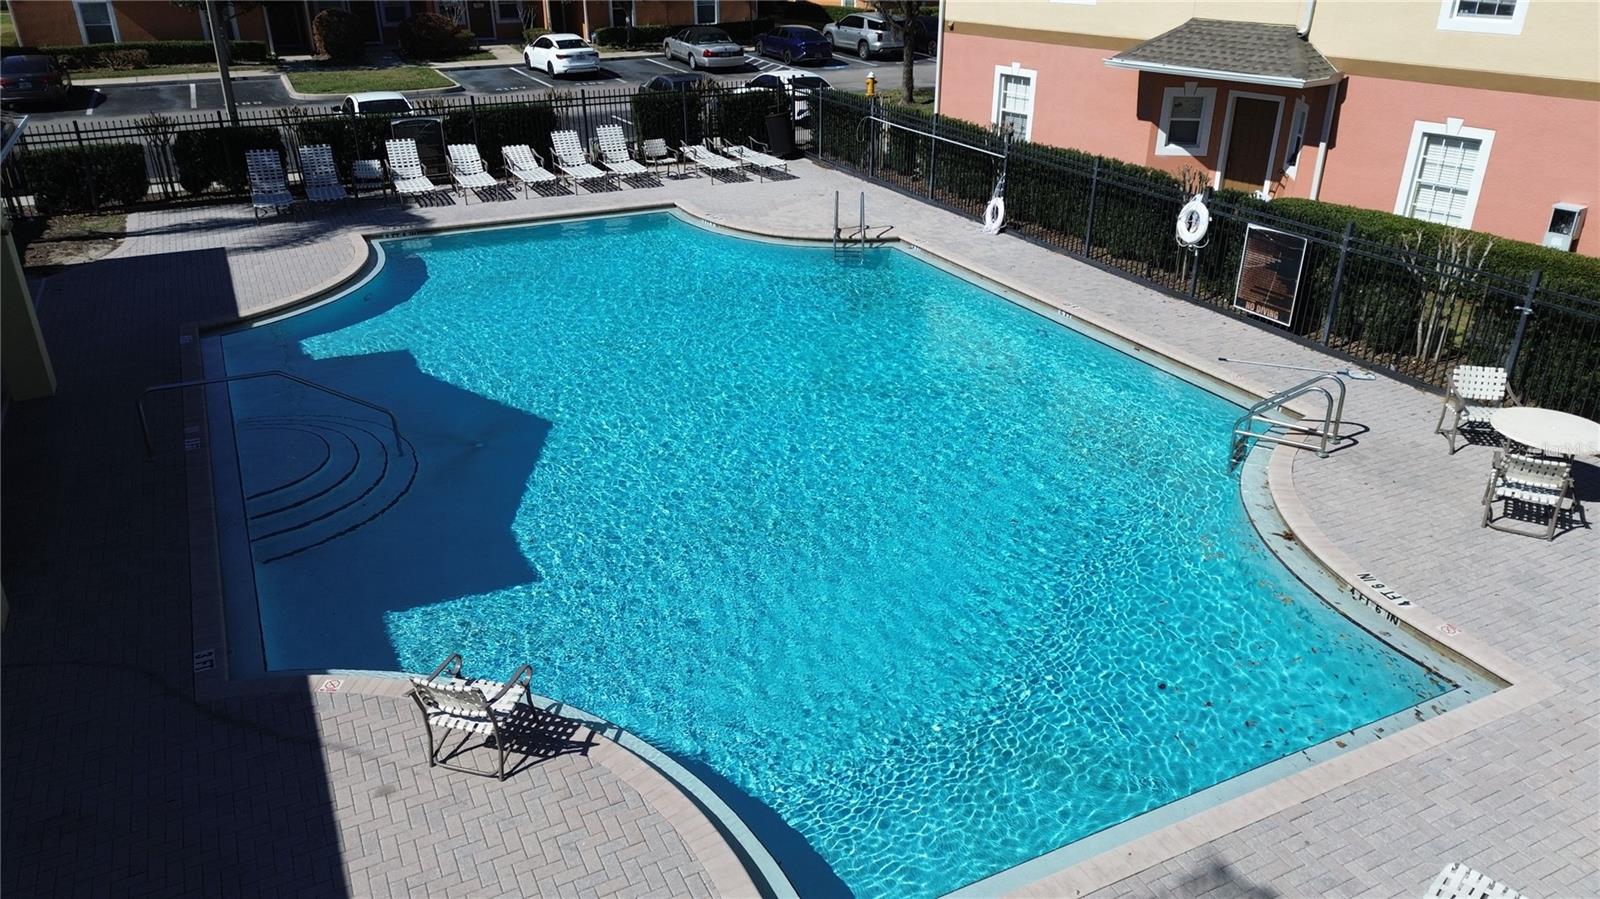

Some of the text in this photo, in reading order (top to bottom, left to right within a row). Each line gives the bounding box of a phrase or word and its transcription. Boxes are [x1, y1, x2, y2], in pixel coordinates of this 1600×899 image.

[1245, 301, 1280, 320] NO DIVING
[1356, 573, 1377, 582] IN
[1380, 591, 1402, 600] FT
[1386, 612, 1399, 626] IN
